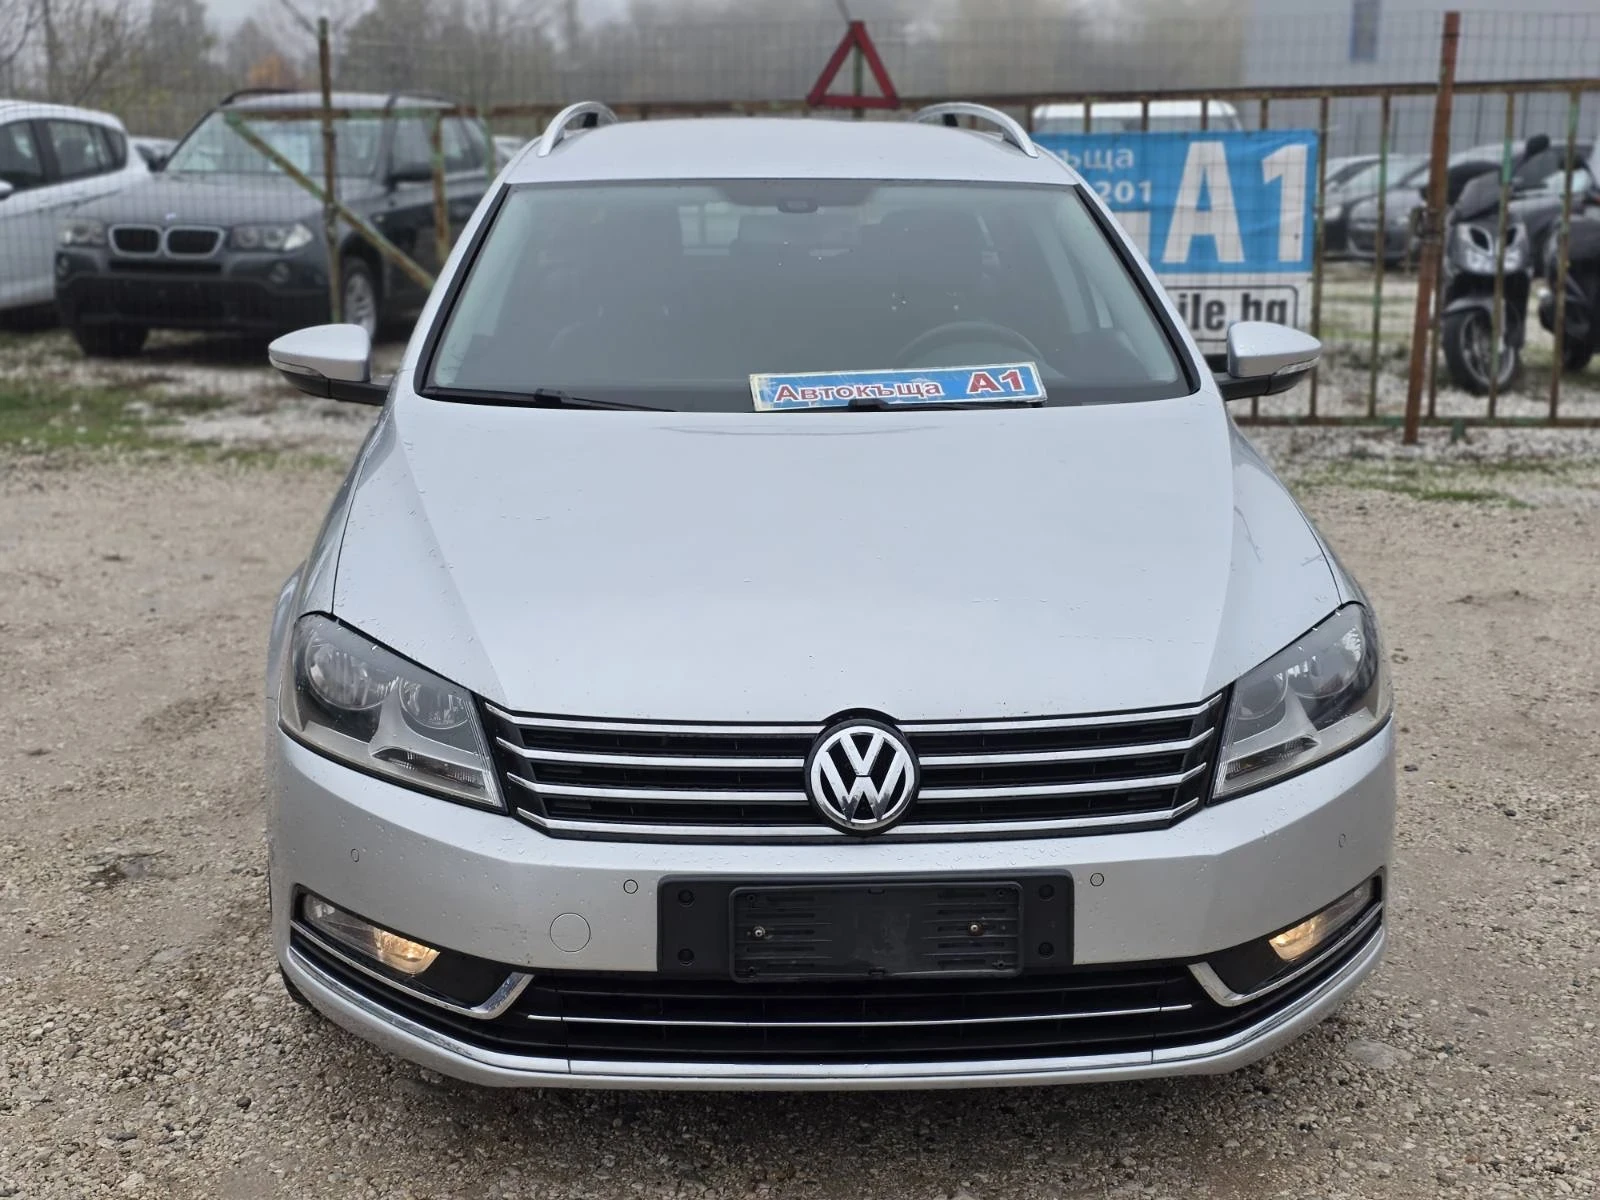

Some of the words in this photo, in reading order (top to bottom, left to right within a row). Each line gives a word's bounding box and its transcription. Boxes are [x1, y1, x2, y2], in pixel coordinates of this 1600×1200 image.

[1178, 292, 1287, 330] ilebg
[775, 381, 943, 402] Автокъща
[819, 732, 907, 823] VW
